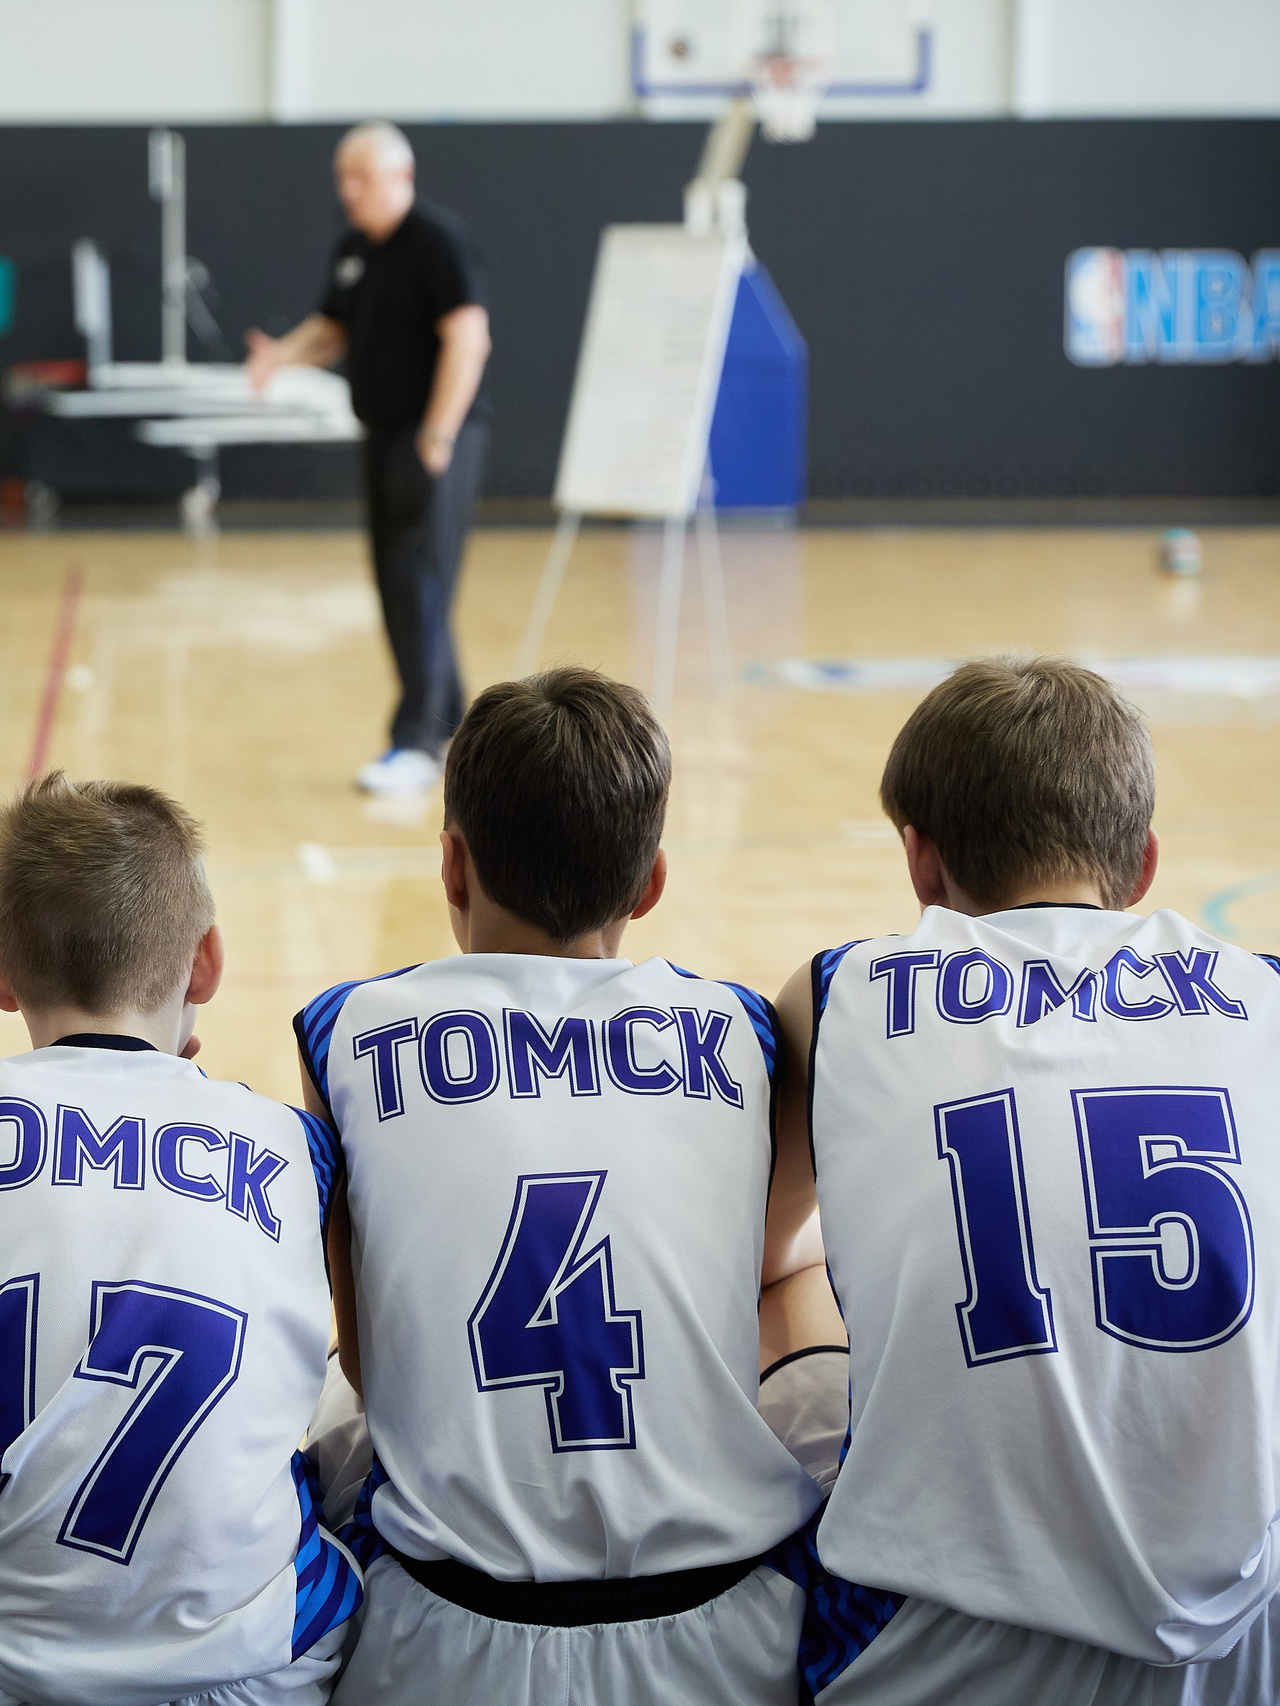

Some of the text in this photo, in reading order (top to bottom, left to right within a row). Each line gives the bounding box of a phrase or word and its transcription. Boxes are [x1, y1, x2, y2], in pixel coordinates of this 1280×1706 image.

[353, 1006, 745, 1122] ТОМСК
[467, 1170, 646, 1454] 4
[933, 1085, 1257, 1368] 15
